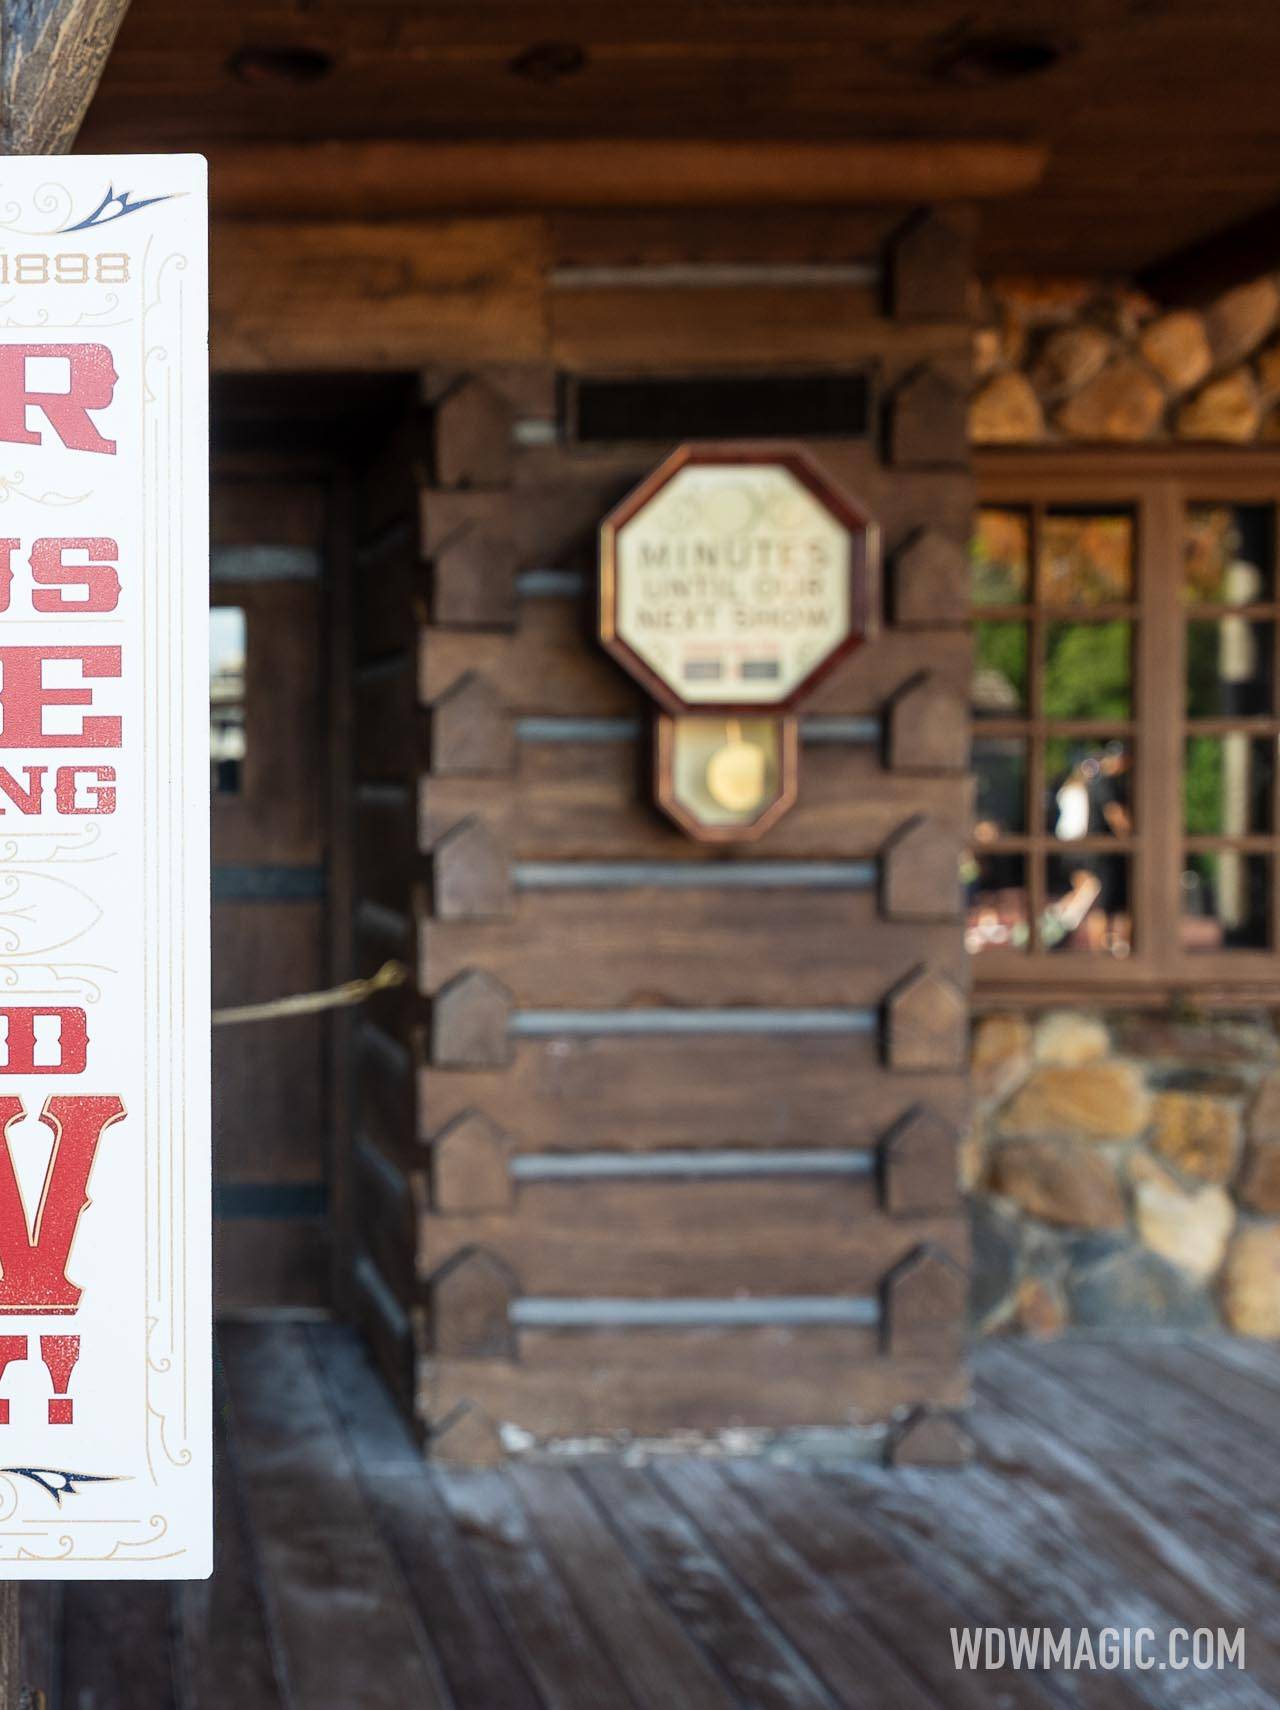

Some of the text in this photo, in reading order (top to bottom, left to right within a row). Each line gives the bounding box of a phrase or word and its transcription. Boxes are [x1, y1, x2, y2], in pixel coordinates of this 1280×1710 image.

[0, 253, 132, 284] 1898
[638, 540, 829, 567] MINUTES
[643, 576, 823, 600] UNTIL OUR
[635, 609, 718, 630] NEXT
